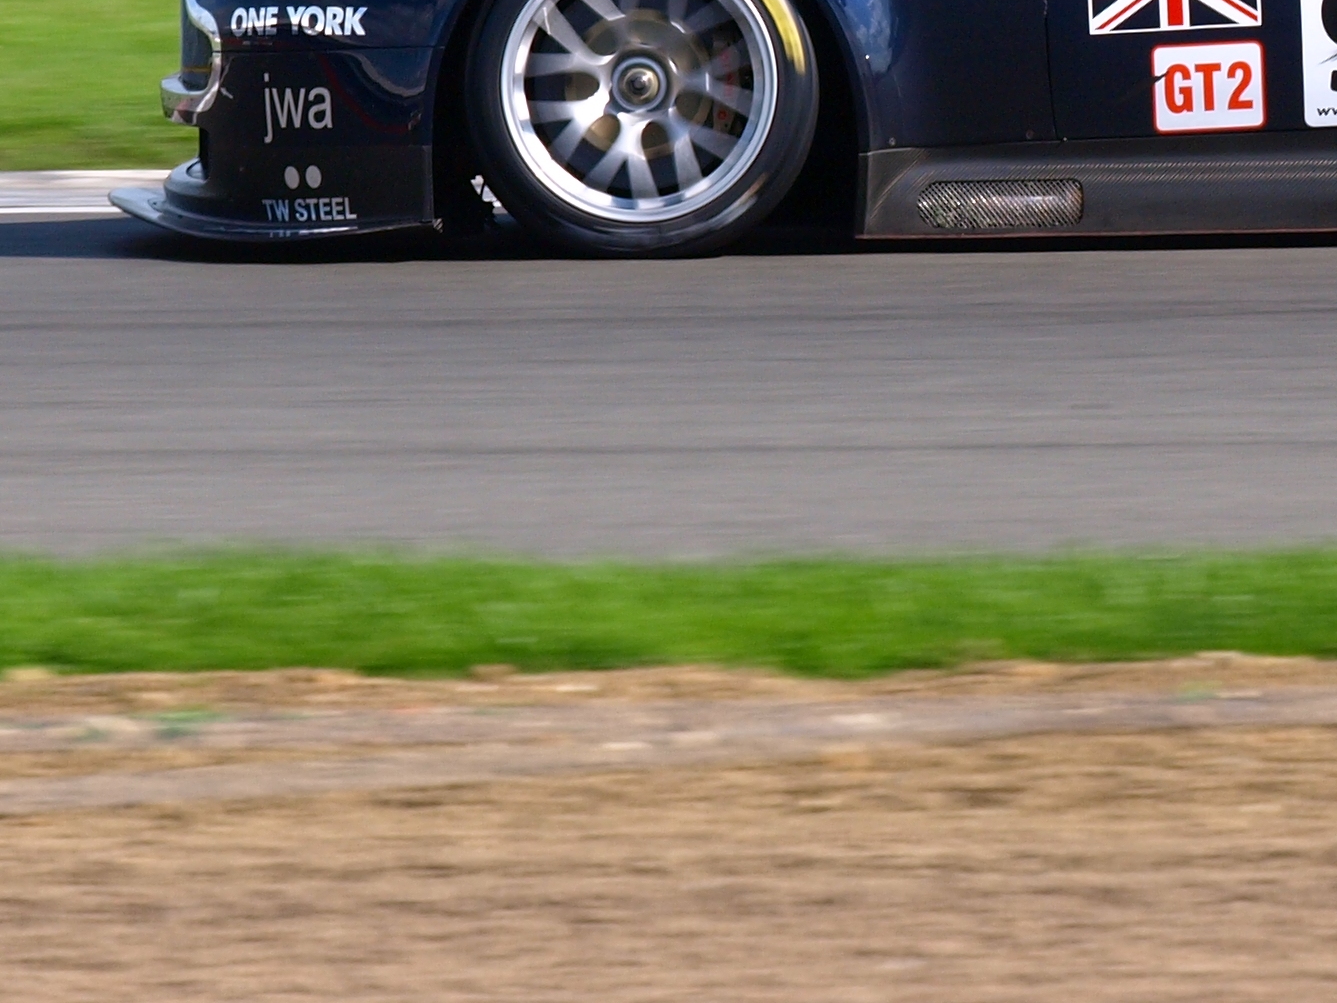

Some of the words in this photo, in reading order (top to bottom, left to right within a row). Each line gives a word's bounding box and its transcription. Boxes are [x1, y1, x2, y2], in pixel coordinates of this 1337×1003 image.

[231, 6, 279, 37] ONE
[286, 6, 368, 37] YORK
[264, 73, 333, 144] jwa
[1163, 61, 1253, 114] GT2
[262, 199, 289, 222] TW
[295, 197, 357, 221] STEEL
